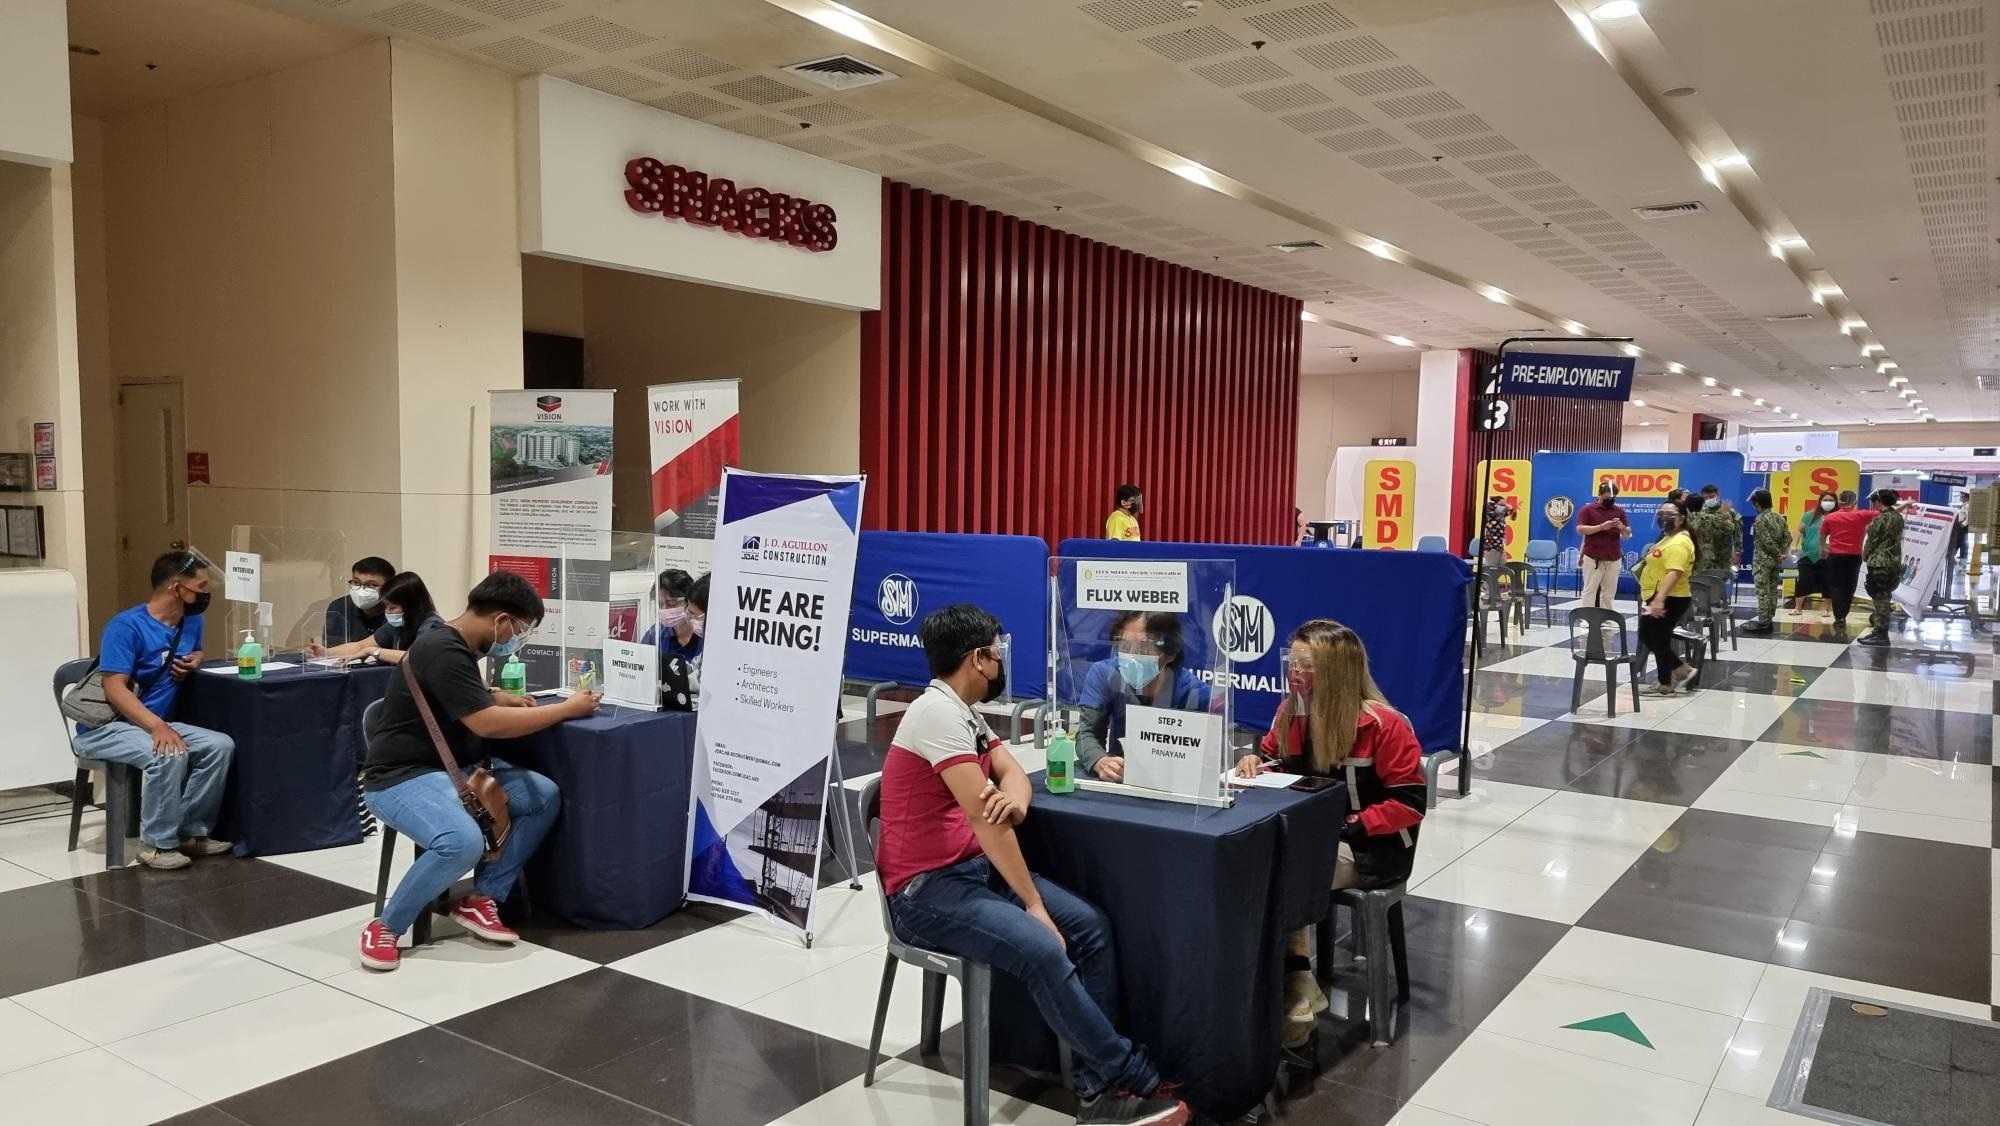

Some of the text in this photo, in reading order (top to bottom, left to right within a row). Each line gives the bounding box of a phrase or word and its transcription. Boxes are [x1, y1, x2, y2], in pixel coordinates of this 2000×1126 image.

[624, 157, 838, 251] SNACKS
[1511, 365, 1621, 388] PRE-EMPLOYMENT
[654, 398, 706, 412] WORK WITH
[1484, 400, 1509, 430] 3
[655, 419, 692, 434] VISION
[1378, 438, 1397, 446] EXIT
[1376, 467, 1403, 551] SMD
[1549, 499, 1569, 517] SM
[782, 540, 828, 552] AGUILLON
[763, 549, 828, 566] CONSTRUCTION
[737, 585, 825, 621] WE ARE
[881, 579, 913, 618] SM
[1086, 588, 1180, 604] FLUX WEBER
[733, 615, 822, 652] HIRING!
[1219, 602, 1264, 654] SM
[527, 648, 552, 657] CONTACT
[612, 659, 645, 672] INTERVIEW
[743, 663, 778, 679] Engineers
[741, 679, 779, 695] Architects
[1189, 667, 1290, 693] UPERMAL
[740, 693, 794, 713] Skilled Workers
[1158, 716, 1183, 727] STEP 2
[1140, 730, 1201, 748] INTERVIEW
[1151, 747, 1186, 760] PANAYAM
